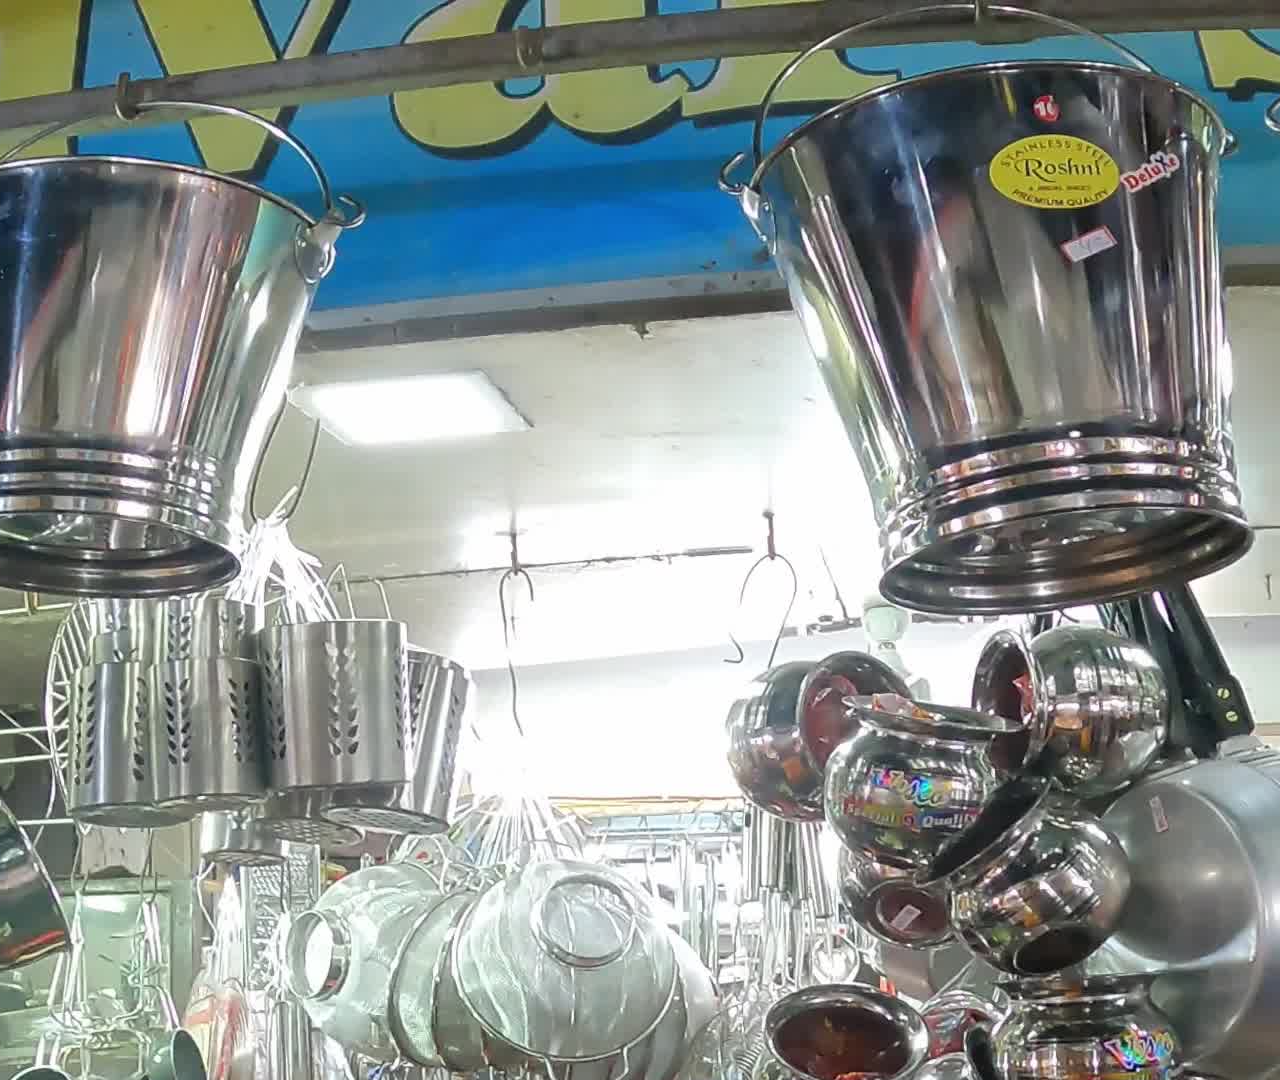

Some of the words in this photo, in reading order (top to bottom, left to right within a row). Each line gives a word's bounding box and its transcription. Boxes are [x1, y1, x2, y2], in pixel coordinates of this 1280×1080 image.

[1000, 139, 1071, 167] STAINLESS
[1074, 142, 1113, 167] STEEL
[1014, 157, 1104, 183] Roshni
[1012, 188, 1065, 206] PREMIUM
[1067, 188, 1109, 207] QUALITY
